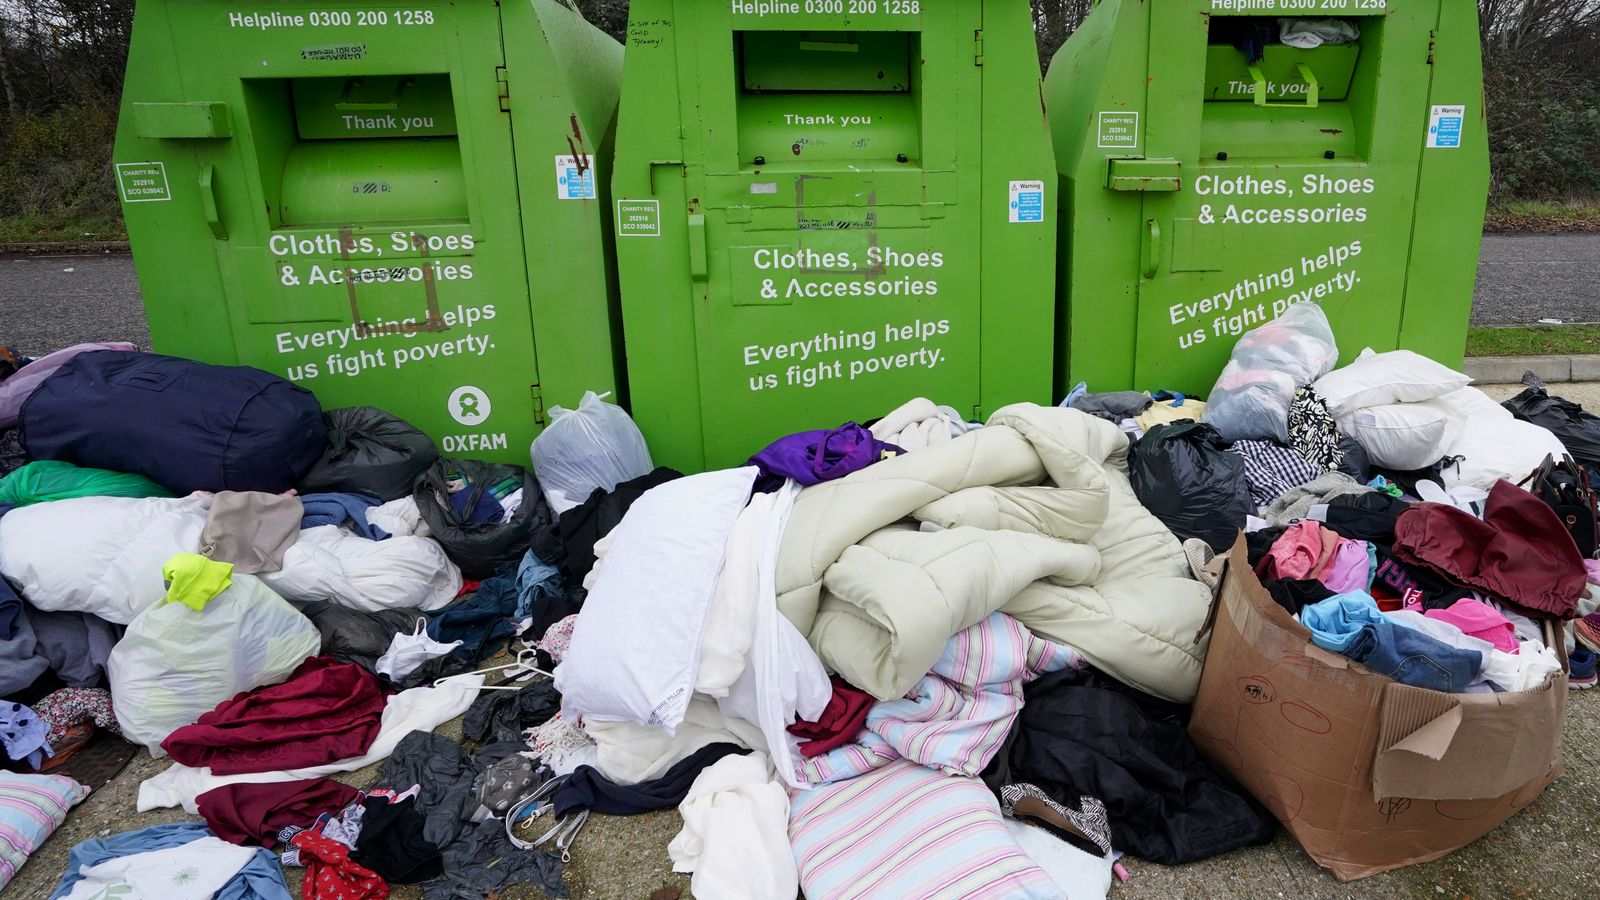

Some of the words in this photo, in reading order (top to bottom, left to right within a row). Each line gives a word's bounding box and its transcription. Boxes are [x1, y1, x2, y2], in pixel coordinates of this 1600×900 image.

[731, 0, 800, 17] Helpline
[804, 0, 843, 14] 0300
[848, 0, 877, 14] 200
[882, 0, 920, 14] 1258
[1211, 0, 1275, 12] Helpline
[229, 11, 304, 30] Helpline
[309, 11, 351, 26] 0300
[356, 11, 388, 26] 200
[394, 10, 434, 25] 1258
[1228, 80, 1276, 94] Thak
[1281, 82, 1308, 97] you
[341, 114, 397, 129] Thank
[401, 117, 434, 132] you
[783, 114, 835, 125] Thank
[840, 116, 871, 127] you
[1195, 175, 1294, 198] Clothes,
[1302, 174, 1375, 195] Shoes
[1198, 204, 1215, 225] &
[1221, 203, 1367, 225] Accessories
[269, 233, 383, 257] Clothes,
[753, 248, 857, 271] Clothes,
[866, 246, 944, 268] Shoes
[280, 265, 301, 286] &
[308, 261, 473, 286] Accessoies
[1169, 266, 1295, 325] Everything
[1301, 240, 1362, 276] helps
[760, 278, 778, 299] &
[785, 275, 938, 298] Accessories
[1178, 328, 1206, 349] us
[1212, 302, 1266, 337] fight
[1272, 270, 1360, 320] poverty.
[743, 330, 876, 366] Everything
[885, 318, 950, 343] helps
[287, 362, 319, 382] us
[326, 348, 386, 377] fight
[393, 333, 496, 368] poverty.
[749, 372, 778, 391] us
[786, 359, 842, 388] fight
[850, 346, 945, 380] poverty.
[442, 432, 508, 453] OXFAM
